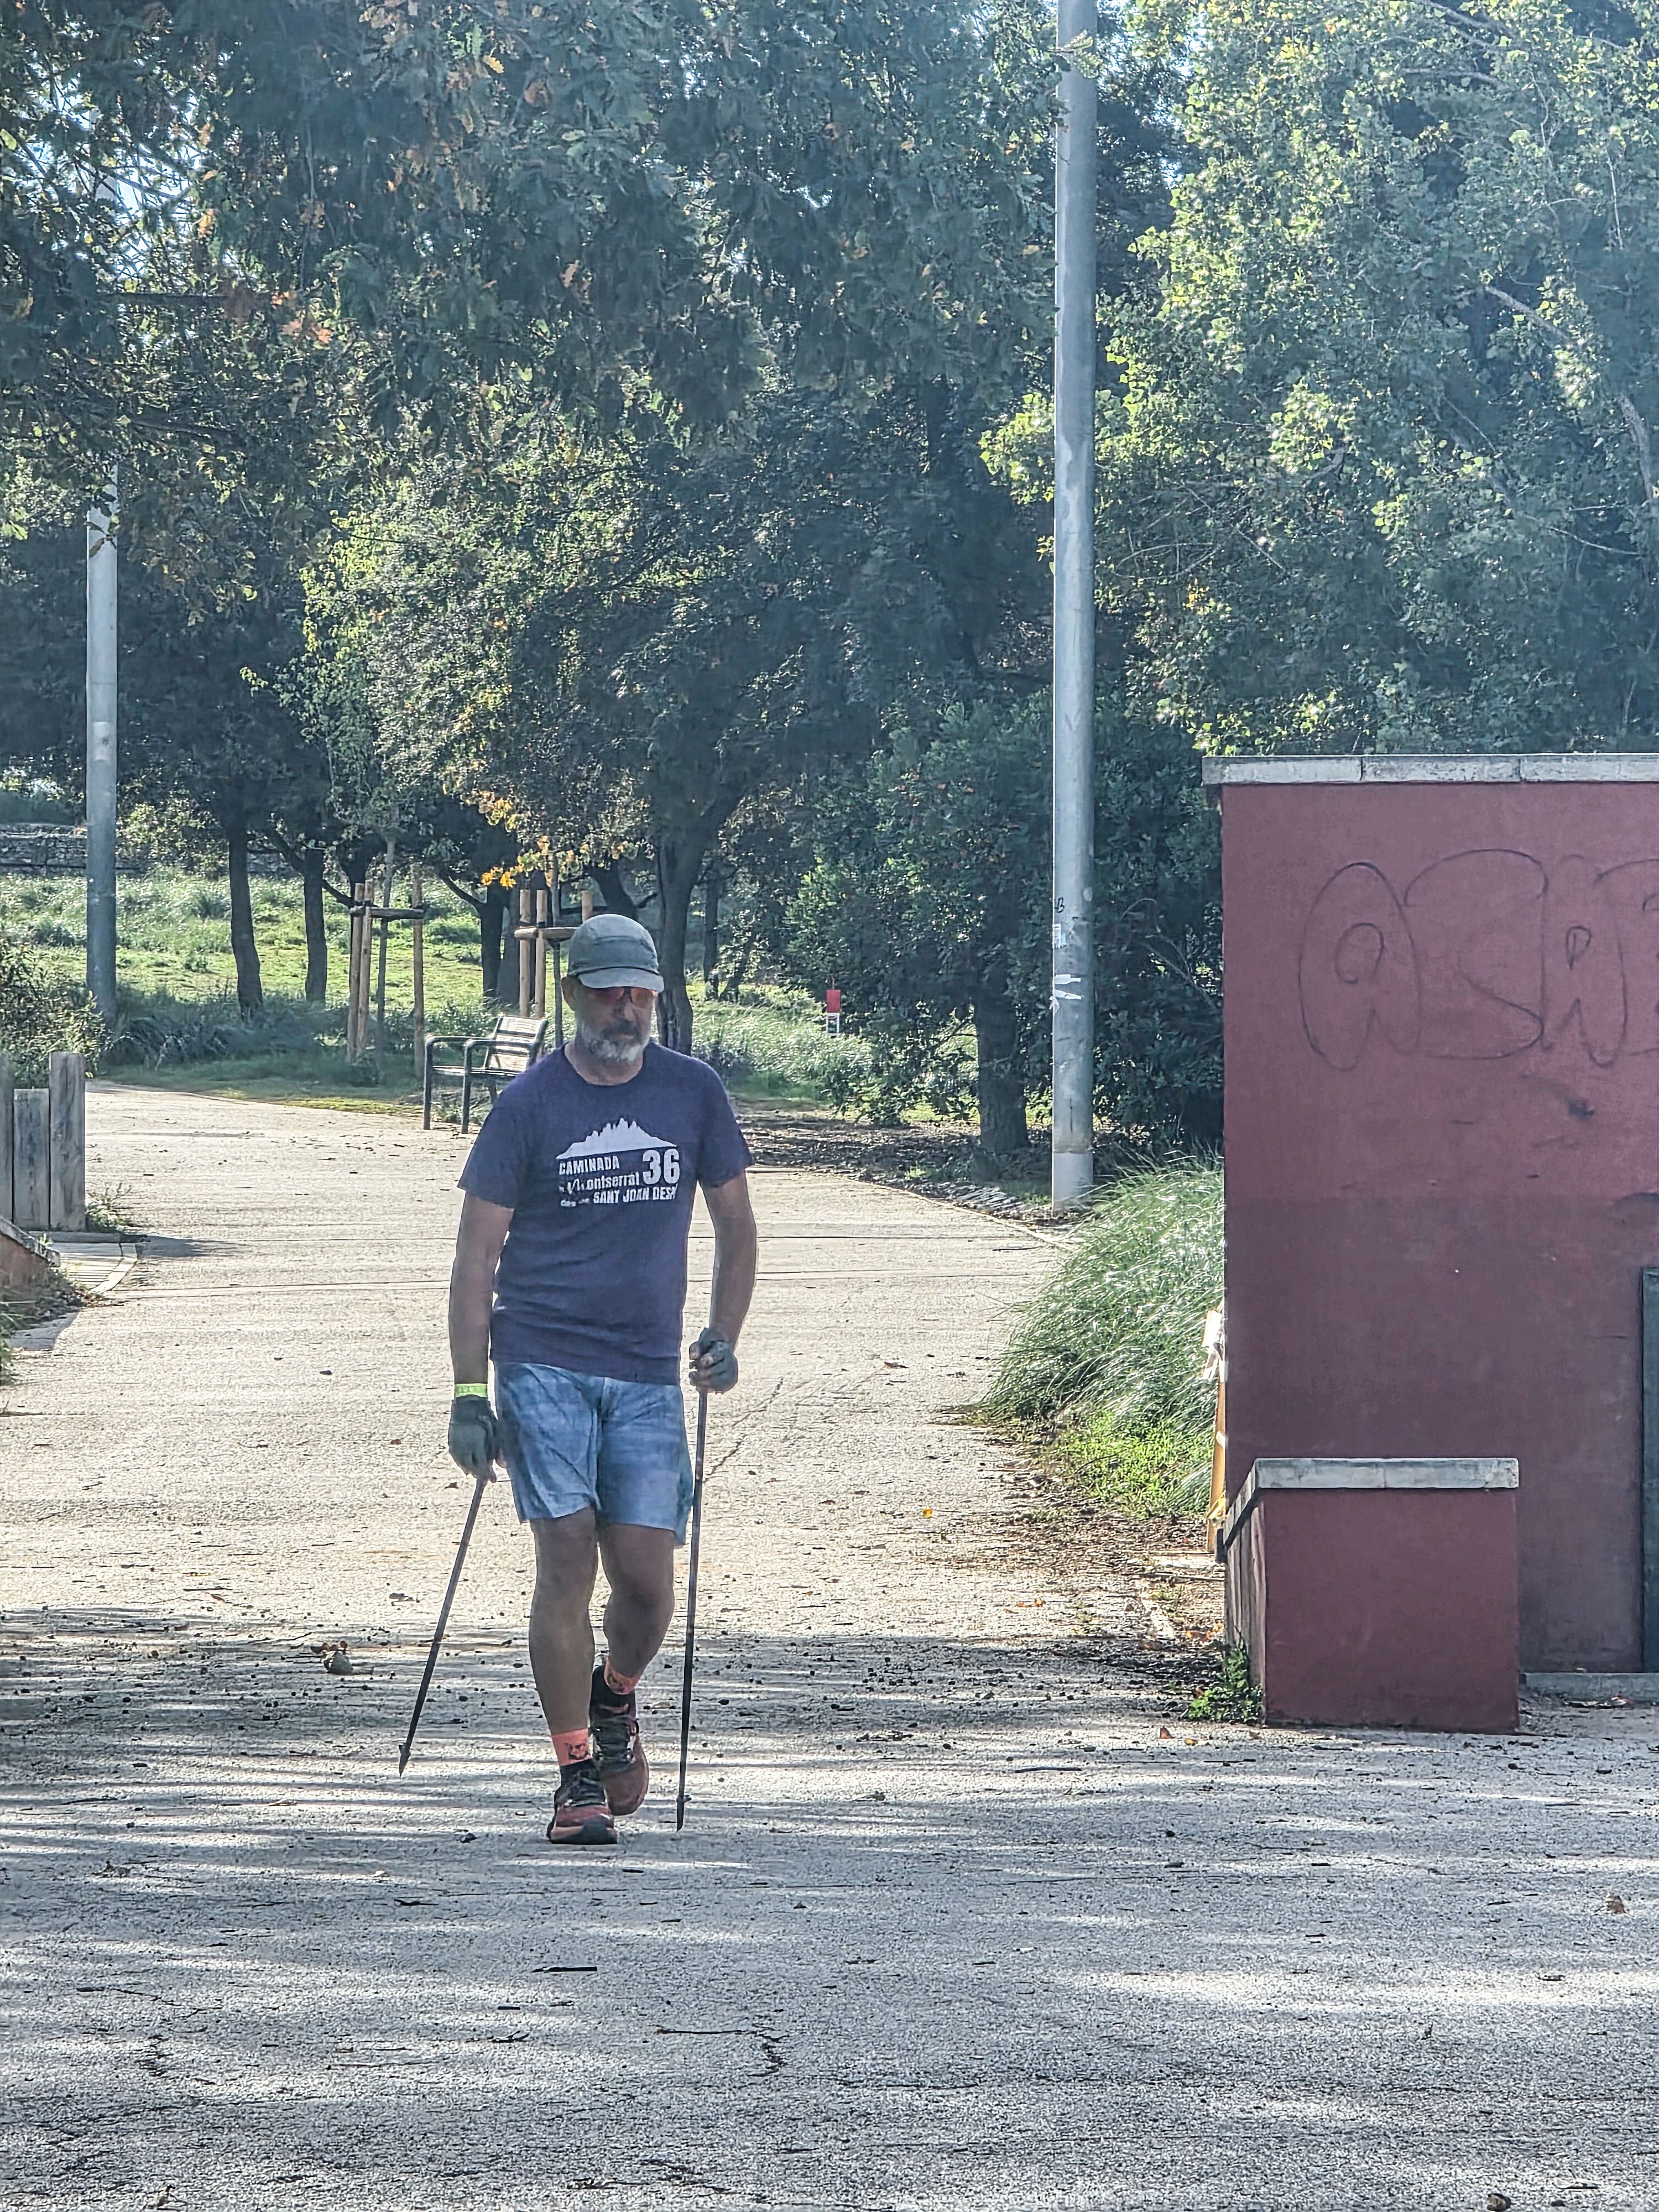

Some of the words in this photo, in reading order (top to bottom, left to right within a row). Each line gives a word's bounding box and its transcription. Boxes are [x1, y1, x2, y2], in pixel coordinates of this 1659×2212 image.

[559, 1156, 620, 1175] CAMINADA
[642, 1148, 680, 1185] 36
[593, 1190, 620, 1203] SANT
[623, 1187, 649, 1202] JOAN
